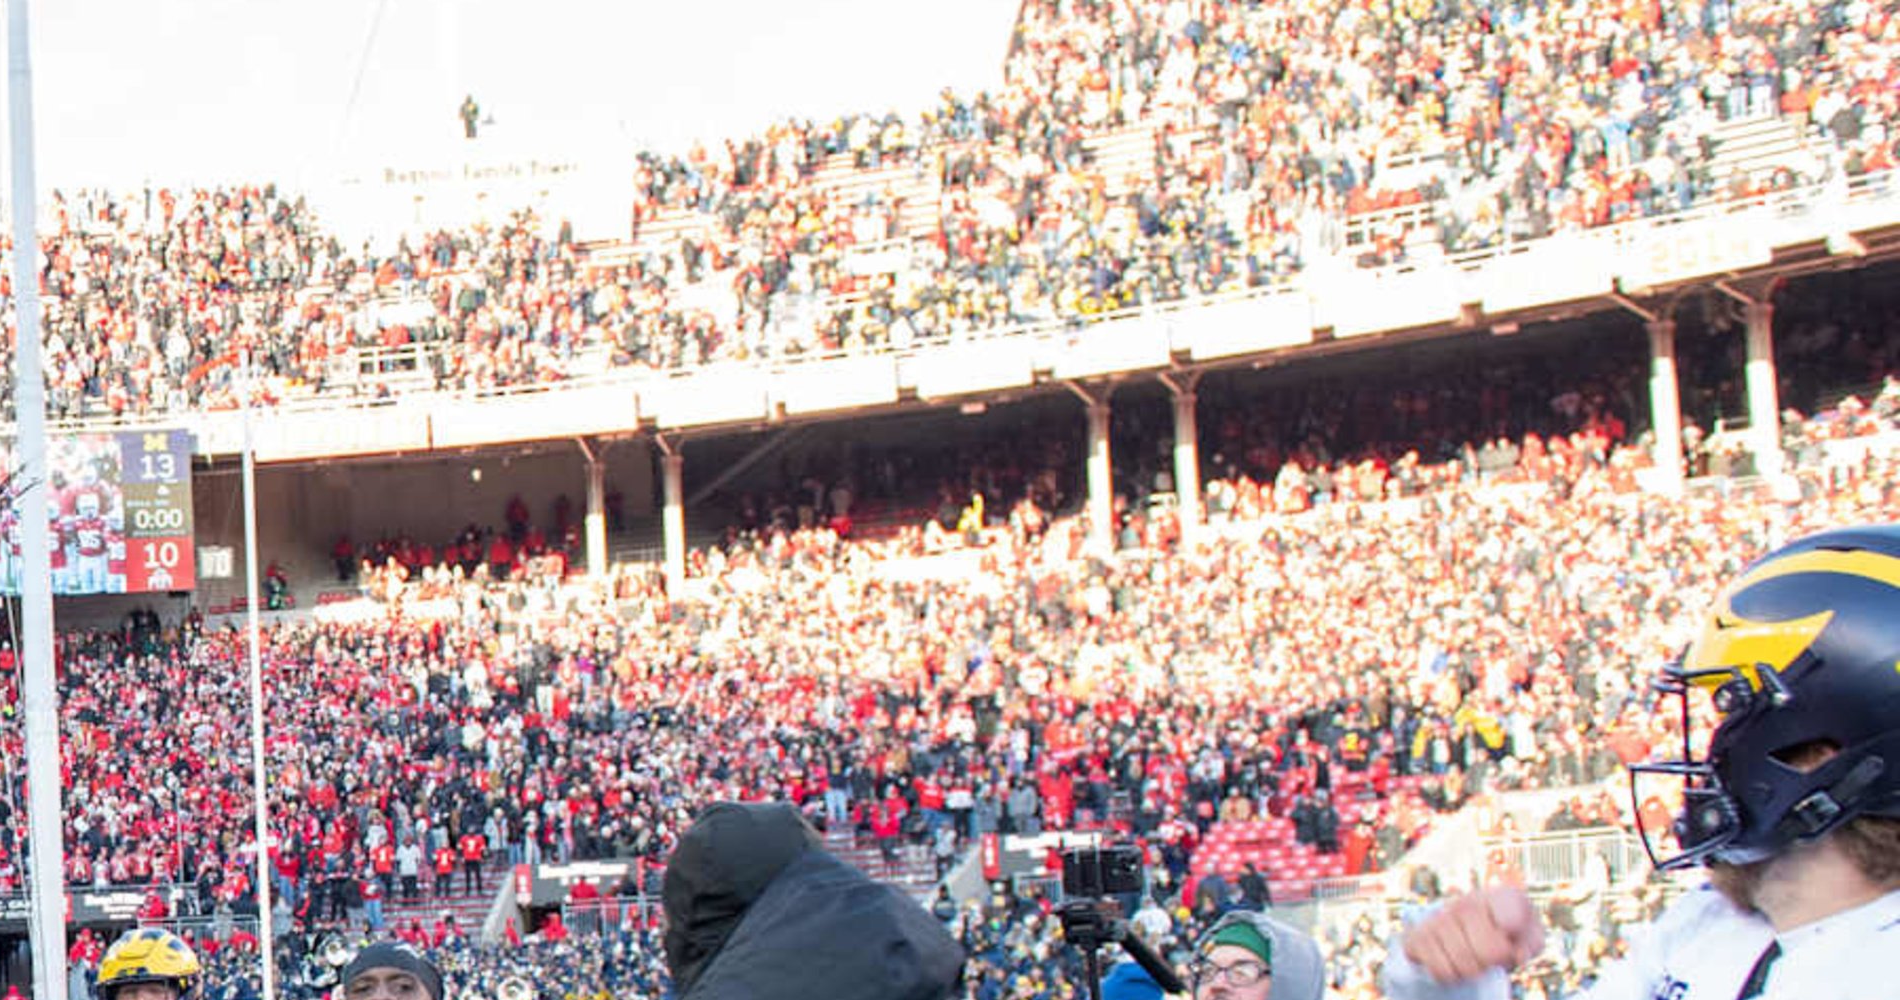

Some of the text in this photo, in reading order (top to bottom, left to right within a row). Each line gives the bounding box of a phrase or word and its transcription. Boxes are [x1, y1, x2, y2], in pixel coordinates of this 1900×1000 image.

[140, 453, 175, 480] 13
[135, 508, 183, 529] 0:00
[144, 542, 178, 569] 10
